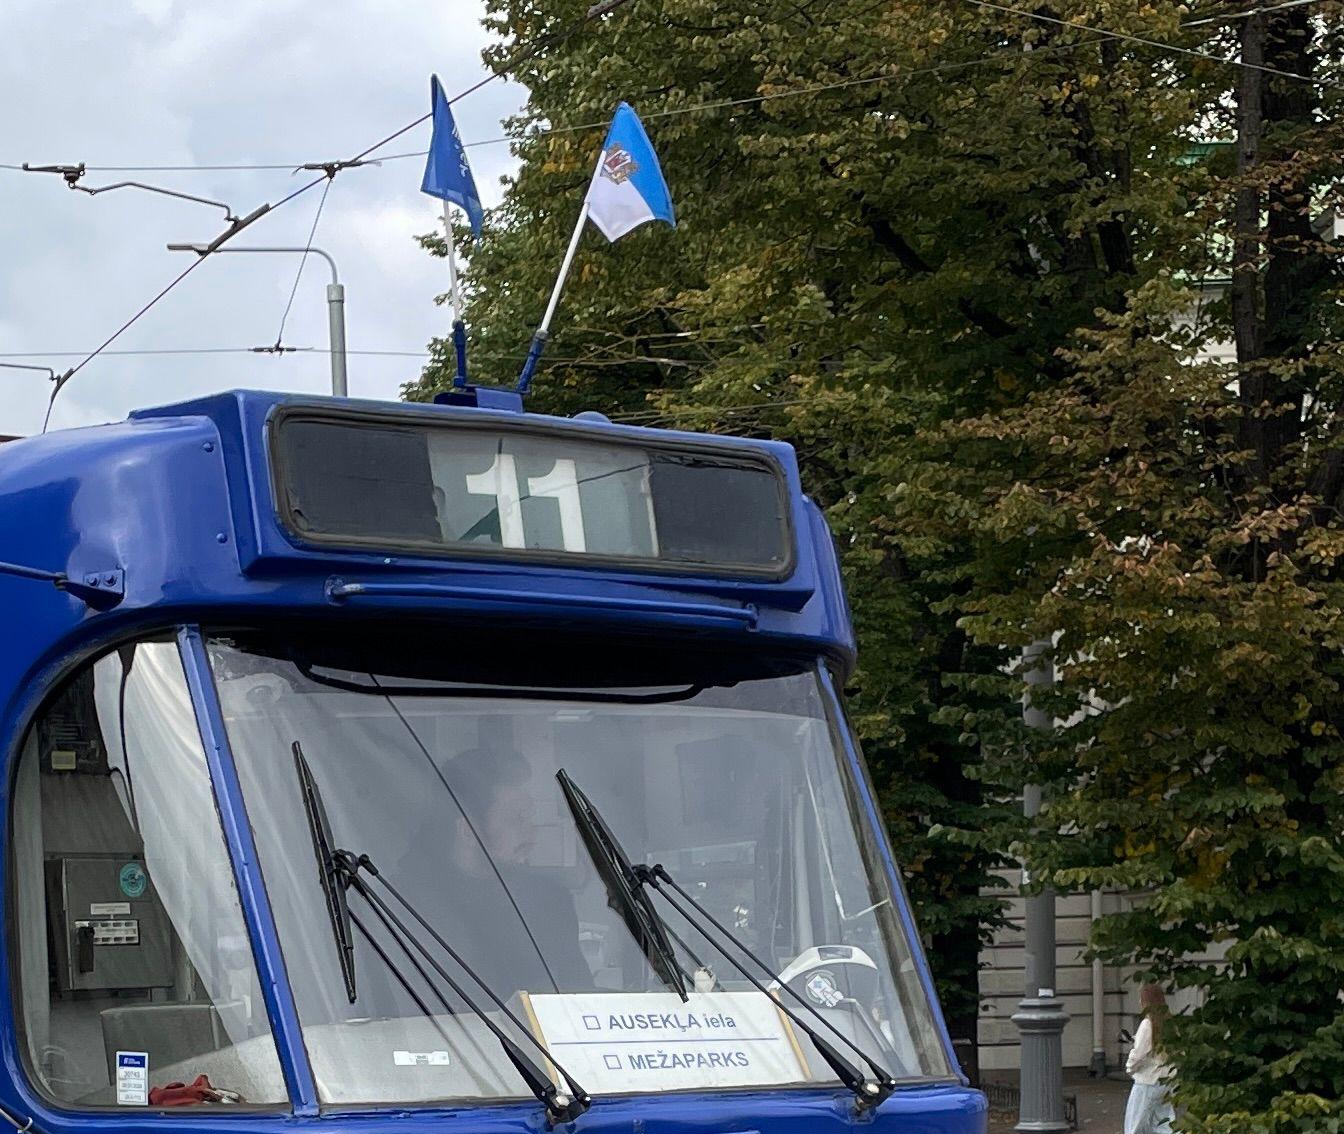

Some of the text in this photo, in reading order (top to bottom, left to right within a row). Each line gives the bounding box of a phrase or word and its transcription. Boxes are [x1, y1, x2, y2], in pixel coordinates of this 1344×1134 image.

[466, 453, 587, 552] 11
[608, 1013, 737, 1032] AUSEKĻA iela
[628, 1050, 749, 1070] MEŽAPARKS
